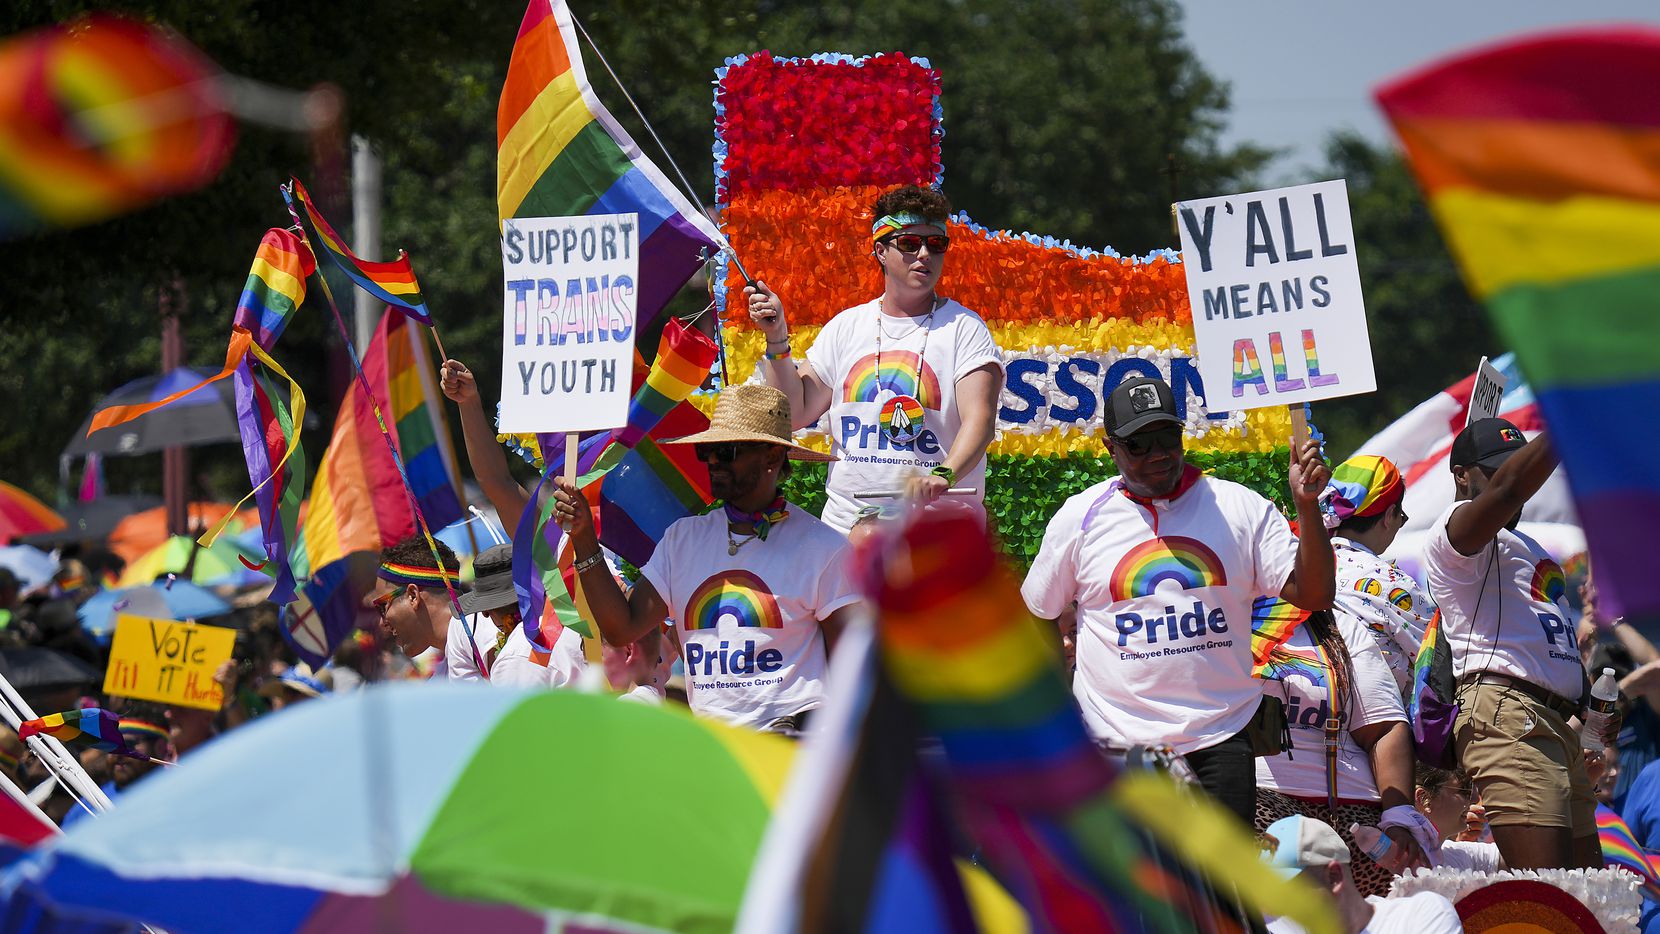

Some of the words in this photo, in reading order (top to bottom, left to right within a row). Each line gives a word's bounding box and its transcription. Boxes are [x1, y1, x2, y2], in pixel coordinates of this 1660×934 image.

[505, 223, 634, 265] SUPPORT
[1180, 192, 1348, 273] Y'ALL
[506, 274, 634, 346] TRANS
[1202, 274, 1332, 321] MEANS
[517, 358, 616, 396] YOUTH
[1231, 328, 1340, 398] ALL
[870, 455, 913, 466] Resource
[1115, 600, 1229, 647] Pride
[1537, 612, 1580, 651] Pri
[685, 639, 784, 677] Pride
[1120, 651, 1162, 661] Employee
[1163, 642, 1206, 657] Resource
[1206, 639, 1233, 650] Group
[716, 680, 753, 689] Resource
[754, 676, 784, 688] Group
